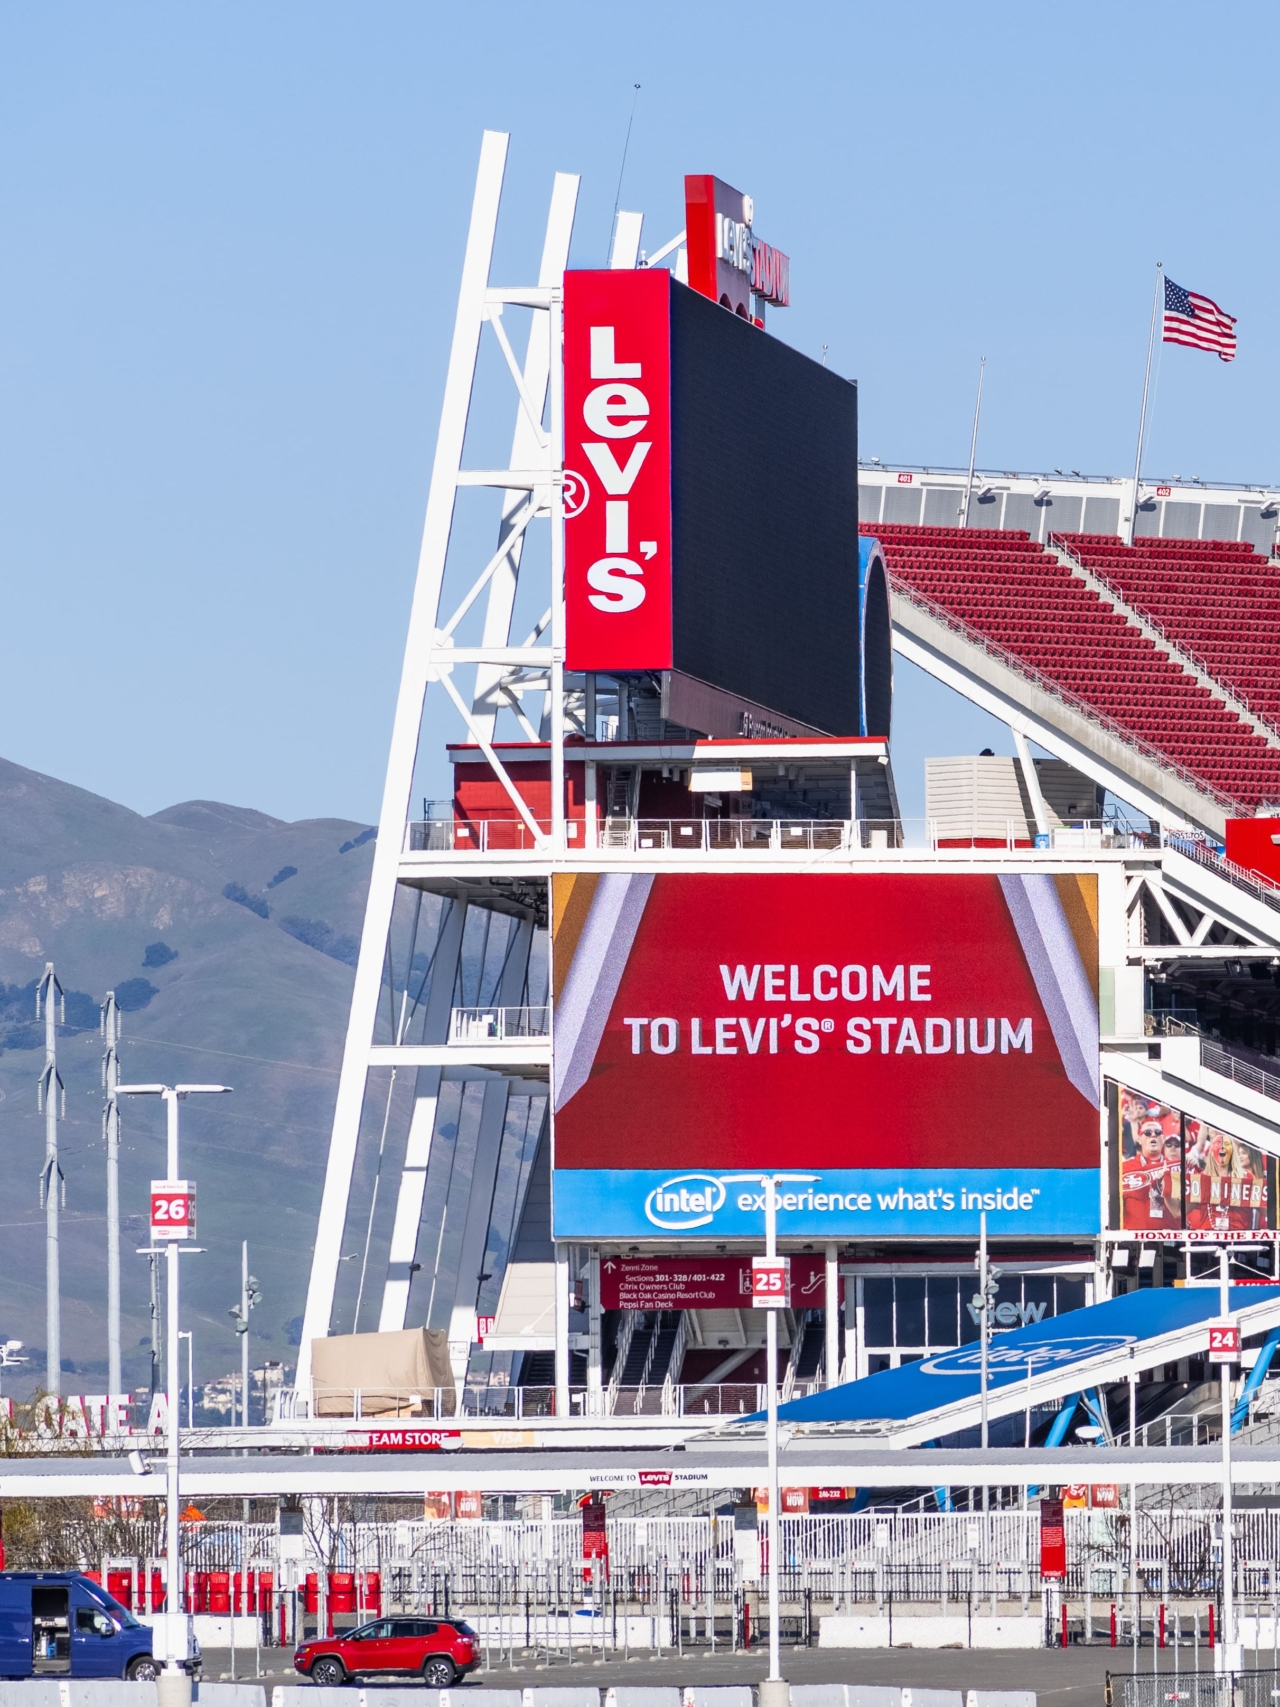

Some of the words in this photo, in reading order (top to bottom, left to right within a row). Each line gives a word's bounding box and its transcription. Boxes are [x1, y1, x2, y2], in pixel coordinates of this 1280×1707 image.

[899, 475, 912, 483] 401
[1157, 488, 1171, 496] 402
[719, 964, 932, 1002] WELCOME
[623, 1017, 680, 1055] TO
[846, 1017, 1034, 1055] STADIUM
[738, 1189, 873, 1213] experience
[877, 1188, 955, 1212] what's
[154, 1198, 186, 1220] 26
[1134, 1232, 1183, 1240] HOME
[1187, 1232, 1208, 1240] OF
[1212, 1232, 1247, 1240] THE
[668, 1282, 685, 1290] Club
[755, 1272, 782, 1291] 25
[676, 1291, 699, 1299] Resort
[699, 1291, 716, 1299] Club
[619, 1301, 639, 1309] Pepsi
[640, 1300, 653, 1308] Fan
[655, 1300, 674, 1308] Deck
[1211, 1332, 1235, 1348] 24
[34, 1394, 134, 1439] GATE
[366, 1433, 403, 1446] TEAM
[492, 1431, 524, 1444] VISA
[460, 1501, 478, 1512] NOW
[786, 1495, 804, 1507] NOW
